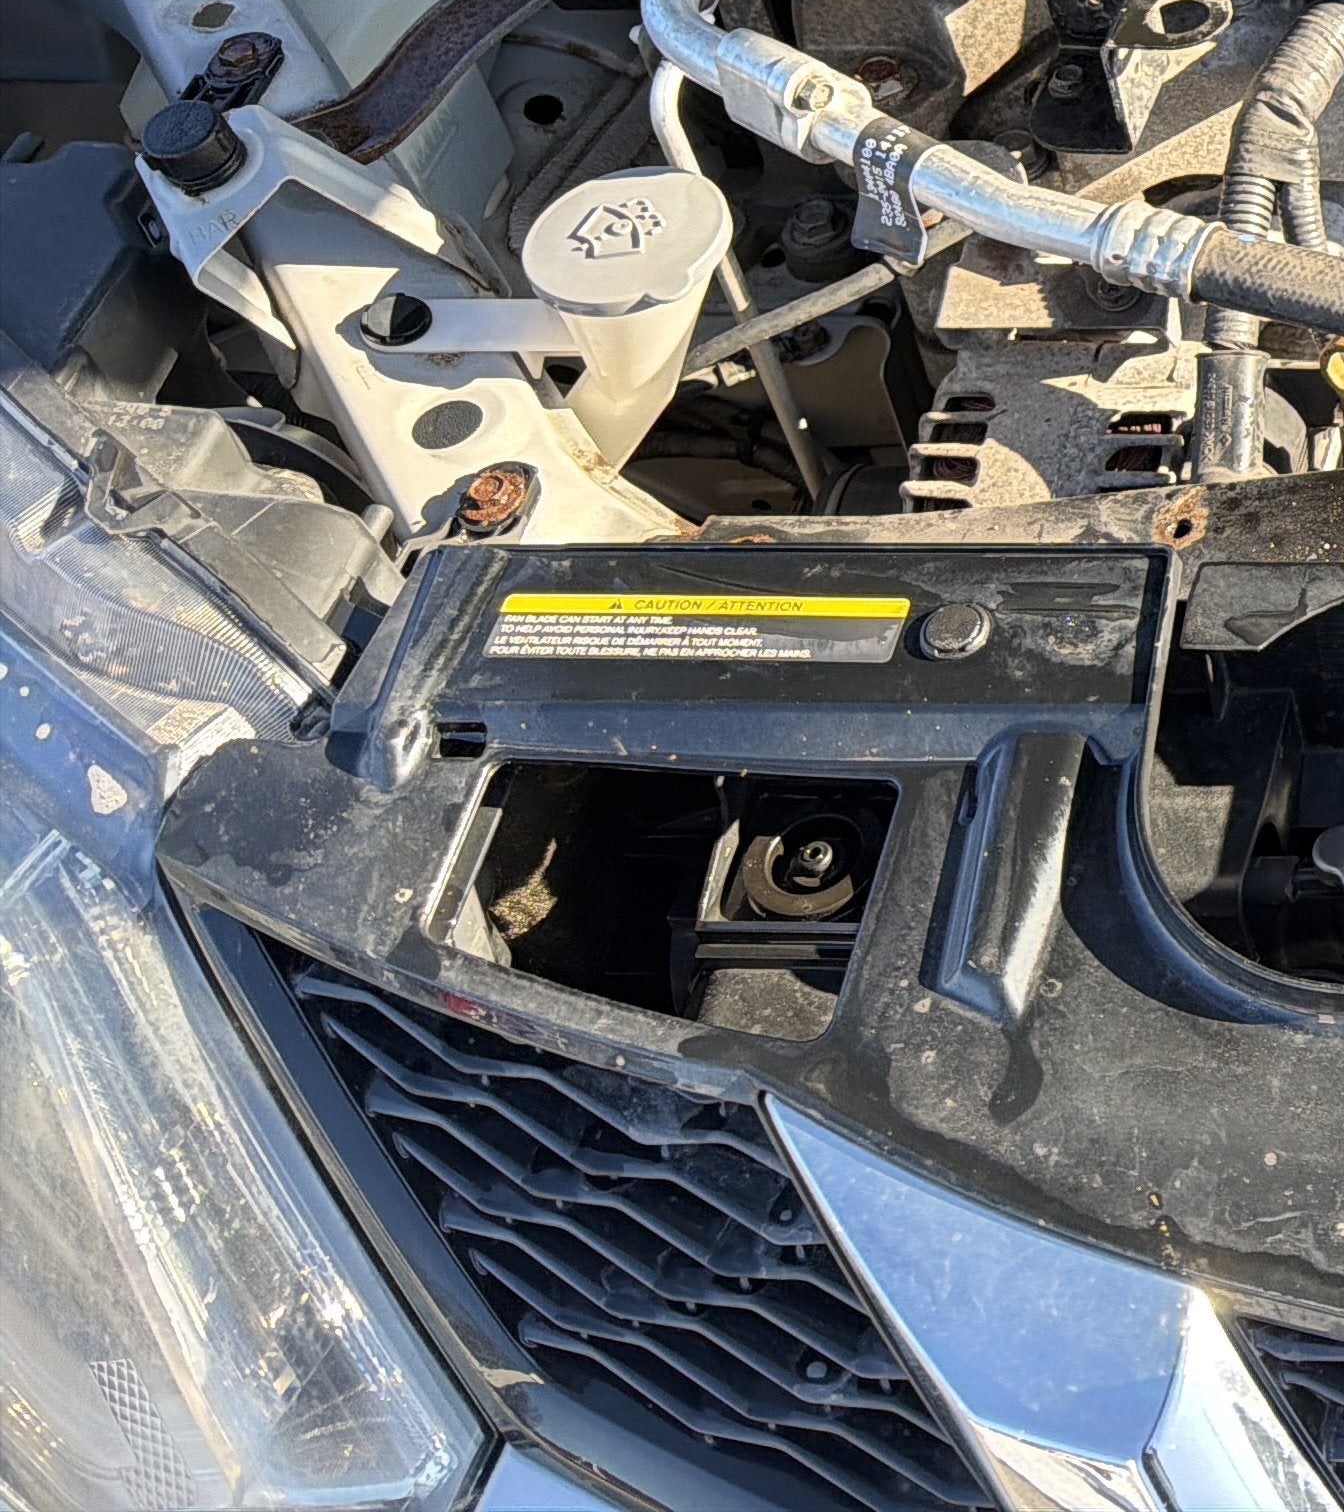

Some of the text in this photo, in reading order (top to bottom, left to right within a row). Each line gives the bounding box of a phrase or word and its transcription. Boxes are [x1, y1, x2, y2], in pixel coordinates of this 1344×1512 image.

[634, 599, 702, 611] CAUTION
[718, 600, 804, 613] ATTENTION
[504, 615, 524, 624] FAN
[525, 615, 557, 624] BLADE
[559, 615, 581, 624] CAN
[582, 616, 612, 624] START
[613, 616, 626, 624] AT
[626, 616, 650, 624] ANY
[500, 625, 514, 633] TO
[515, 625, 541, 633] HELP
[542, 625, 573, 634] AVOID
[574, 625, 625, 634] PERSONAL
[688, 626, 723, 636] HANDS
[494, 636, 506, 644] LE
[507, 636, 571, 645] VENTILATEUR
[611, 637, 625, 645] DE
[691, 638, 717, 647] TOUT
[489, 646, 519, 655] POUR
[555, 647, 587, 656] TOUTE
[643, 648, 660, 656] NE
[660, 648, 680, 657] PAS
[680, 648, 695, 657] EN
[696, 649, 758, 658] APPROCHER
[758, 649, 778, 658] LES
